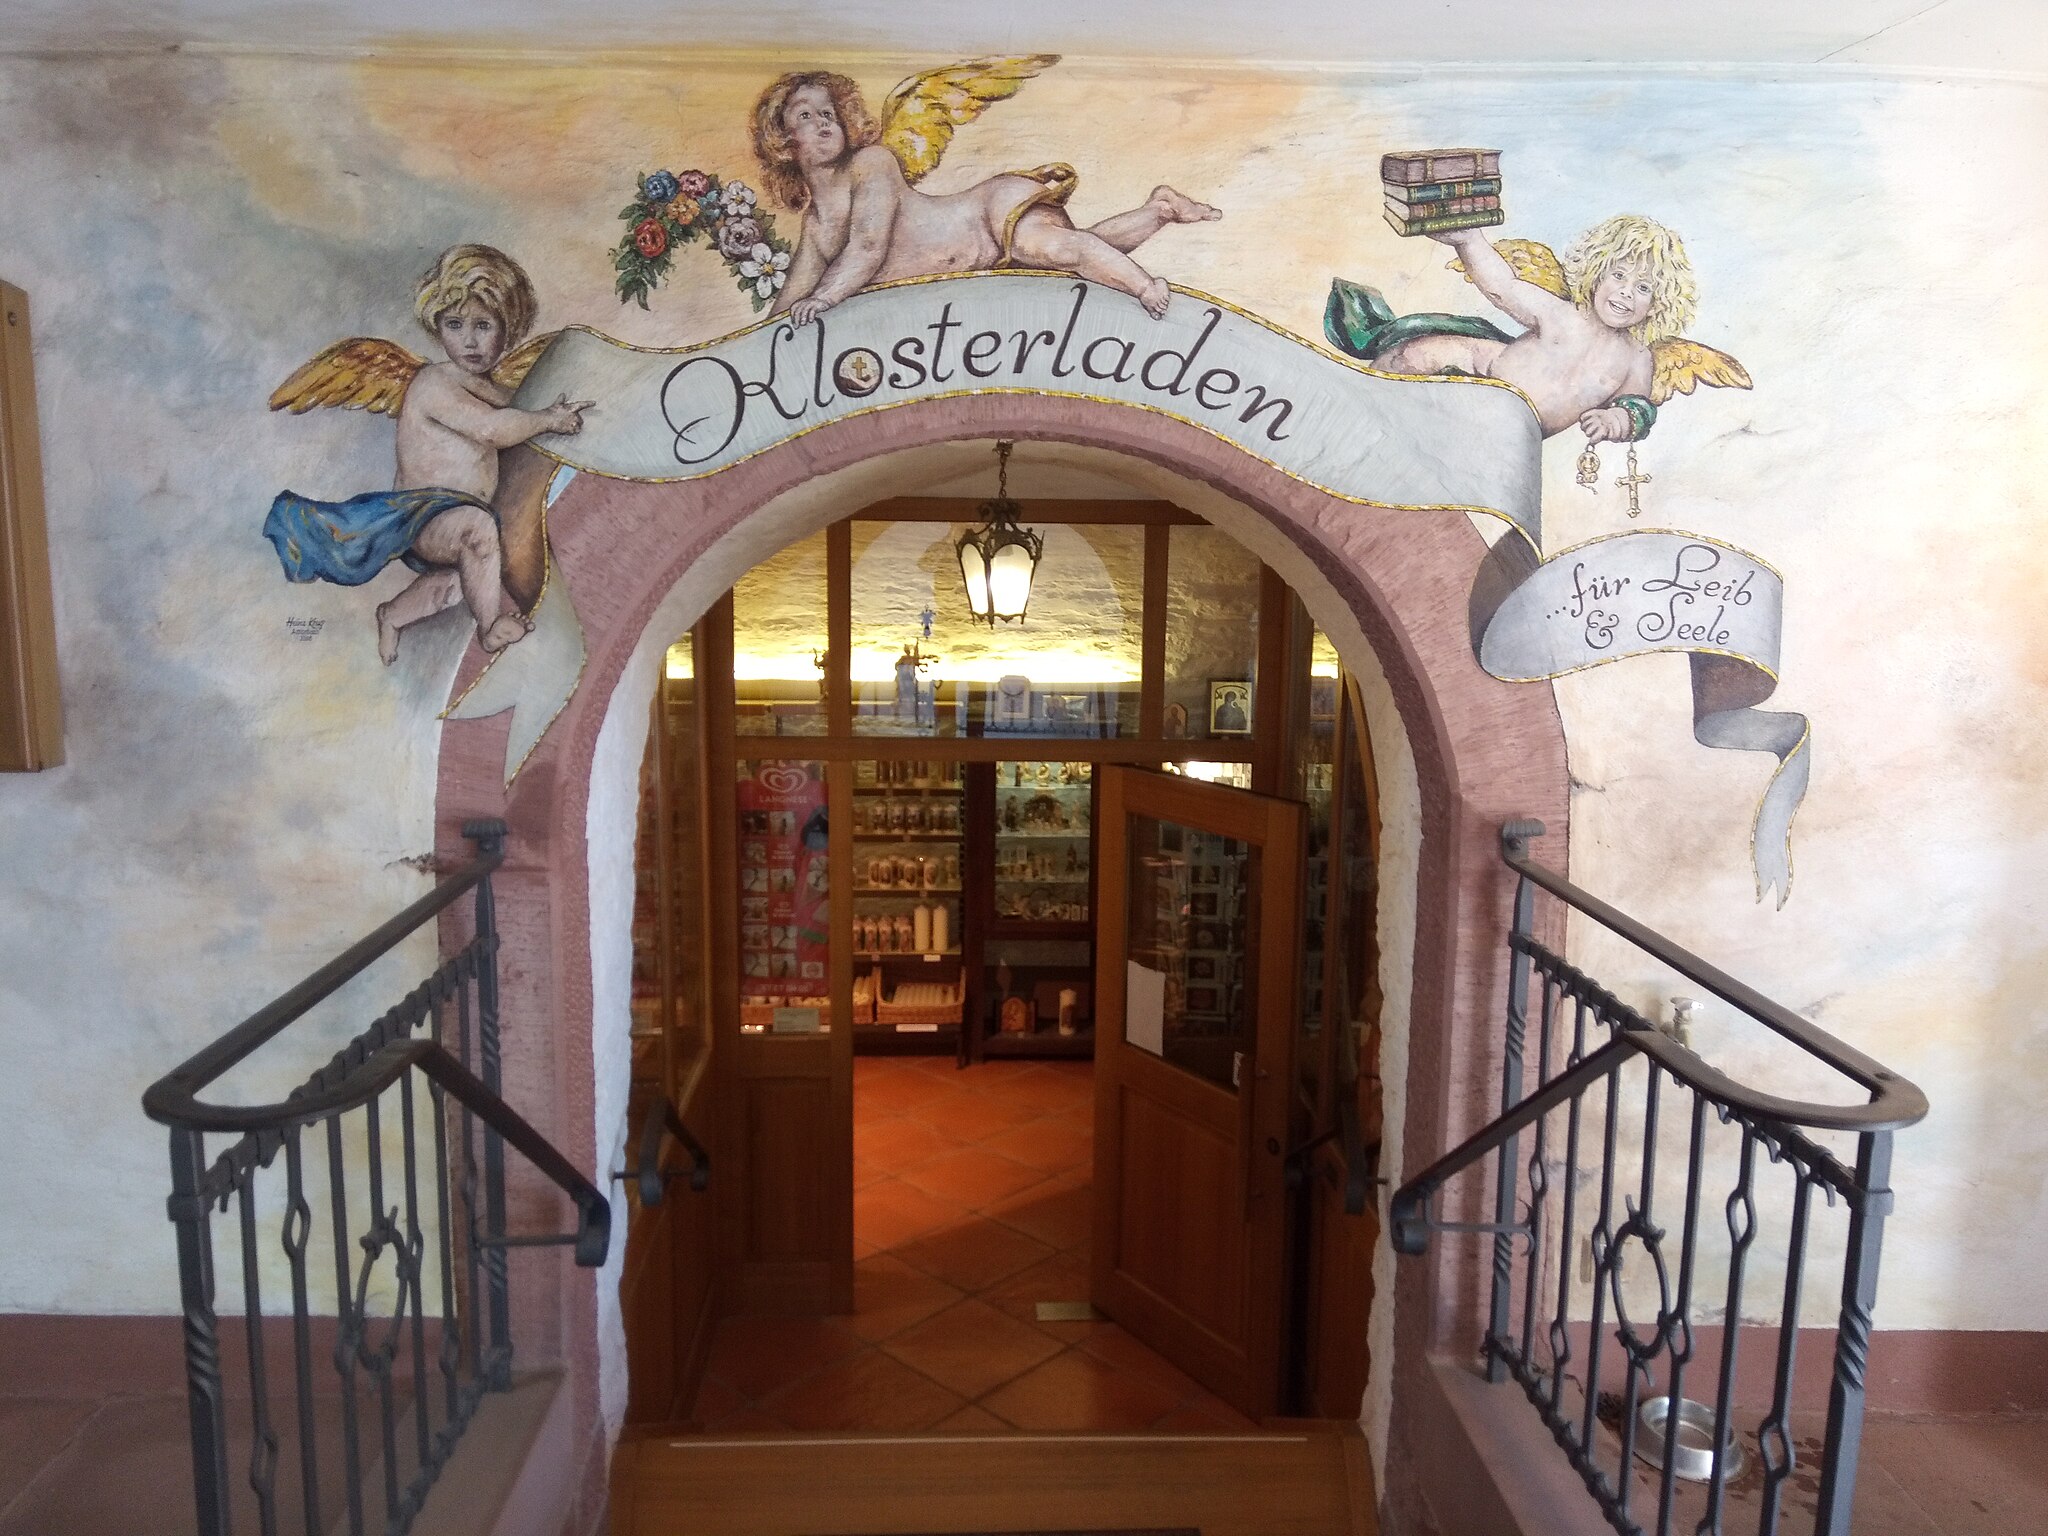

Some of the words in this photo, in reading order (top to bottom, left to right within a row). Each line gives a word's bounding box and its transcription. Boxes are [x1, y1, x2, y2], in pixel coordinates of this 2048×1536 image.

[660, 283, 1293, 463] Klosterladen
[1642, 544, 1755, 605] Leib
[1584, 610, 1620, 649] &
[1636, 592, 1730, 645] Seele
[758, 794, 808, 804] LANGNESE
